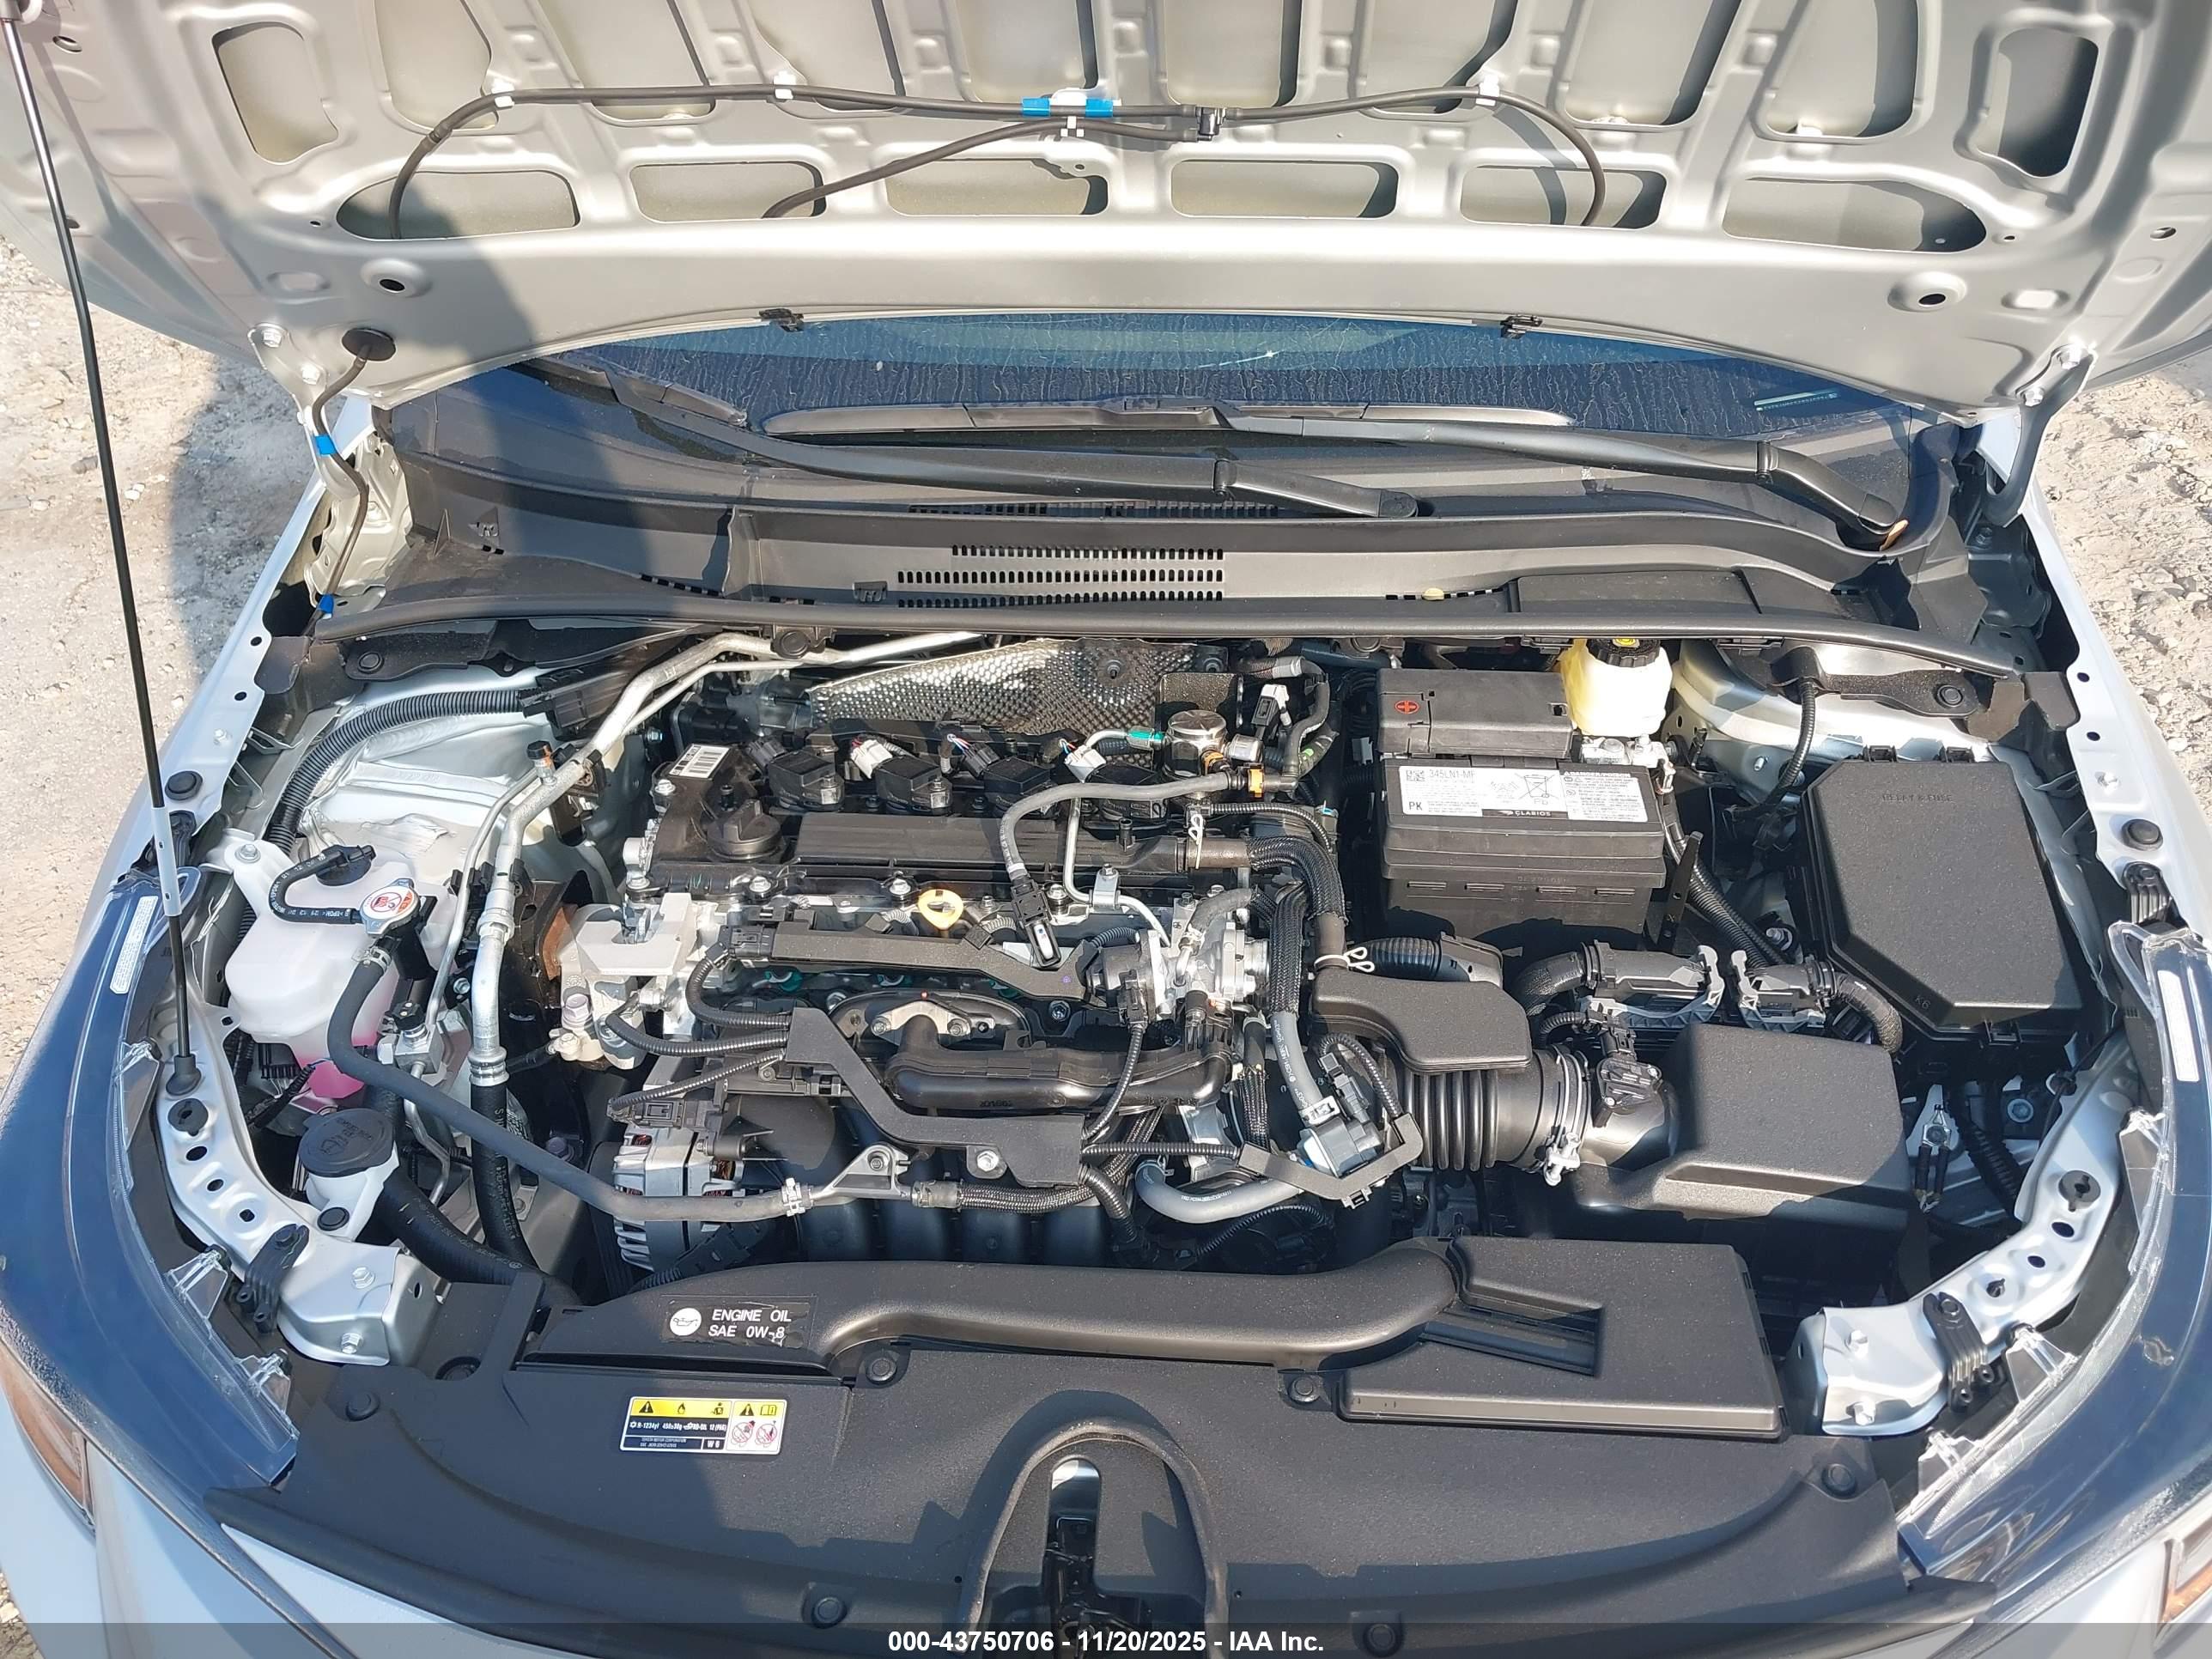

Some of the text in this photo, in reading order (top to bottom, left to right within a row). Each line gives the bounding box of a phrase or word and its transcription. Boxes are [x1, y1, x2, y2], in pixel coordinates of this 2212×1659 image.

[1408, 801, 1423, 811] PK
[711, 1309, 792, 1322] ENGINE OIL
[708, 1325, 786, 1339] SAE 0W-8
